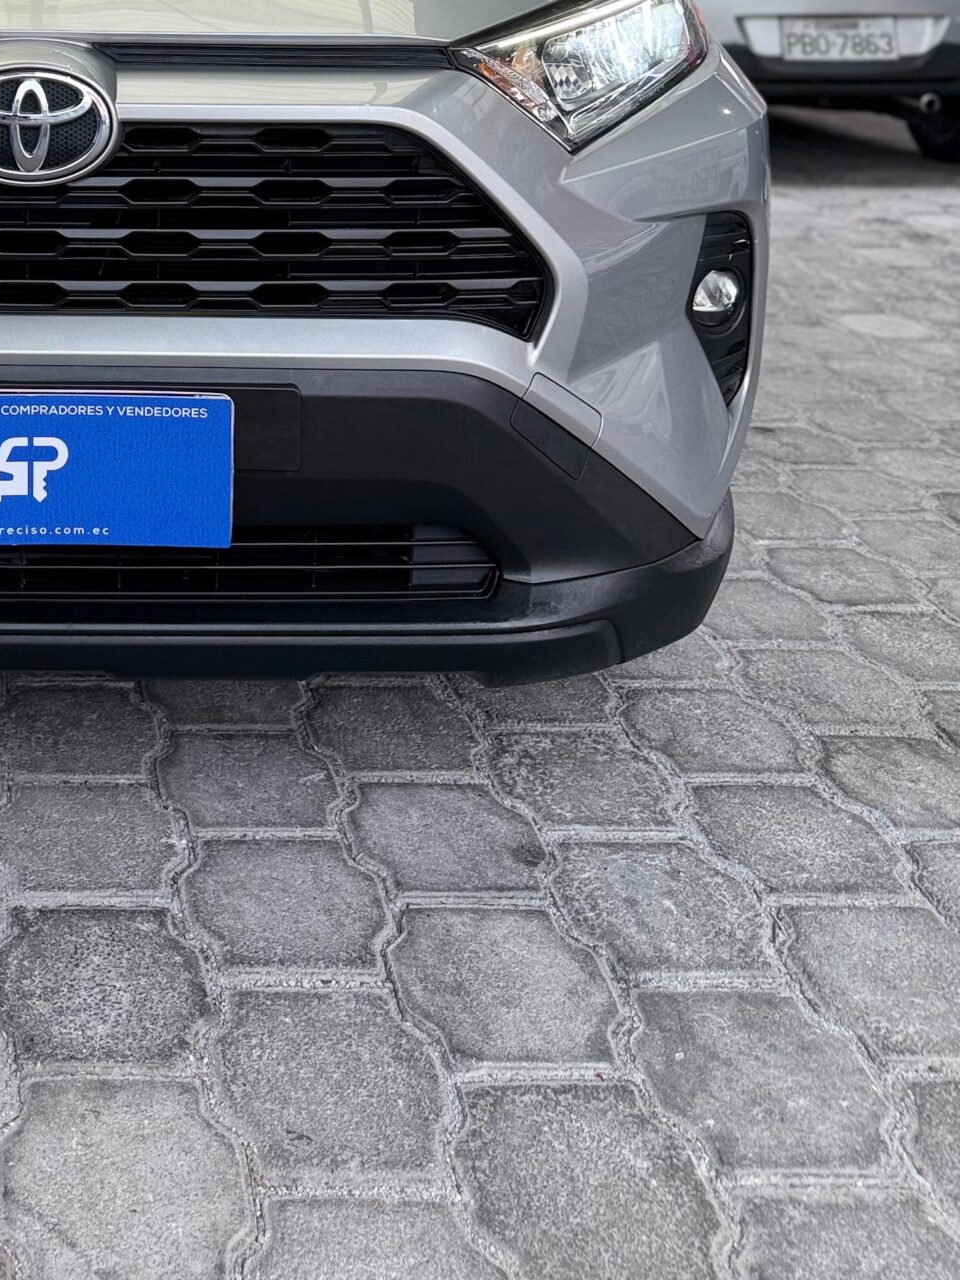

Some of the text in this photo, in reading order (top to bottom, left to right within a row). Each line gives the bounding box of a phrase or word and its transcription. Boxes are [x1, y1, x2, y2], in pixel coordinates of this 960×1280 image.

[0, 405, 104, 416] COMPRADORES
[106, 406, 115, 416] Y
[117, 406, 208, 419] VENDEDORES
